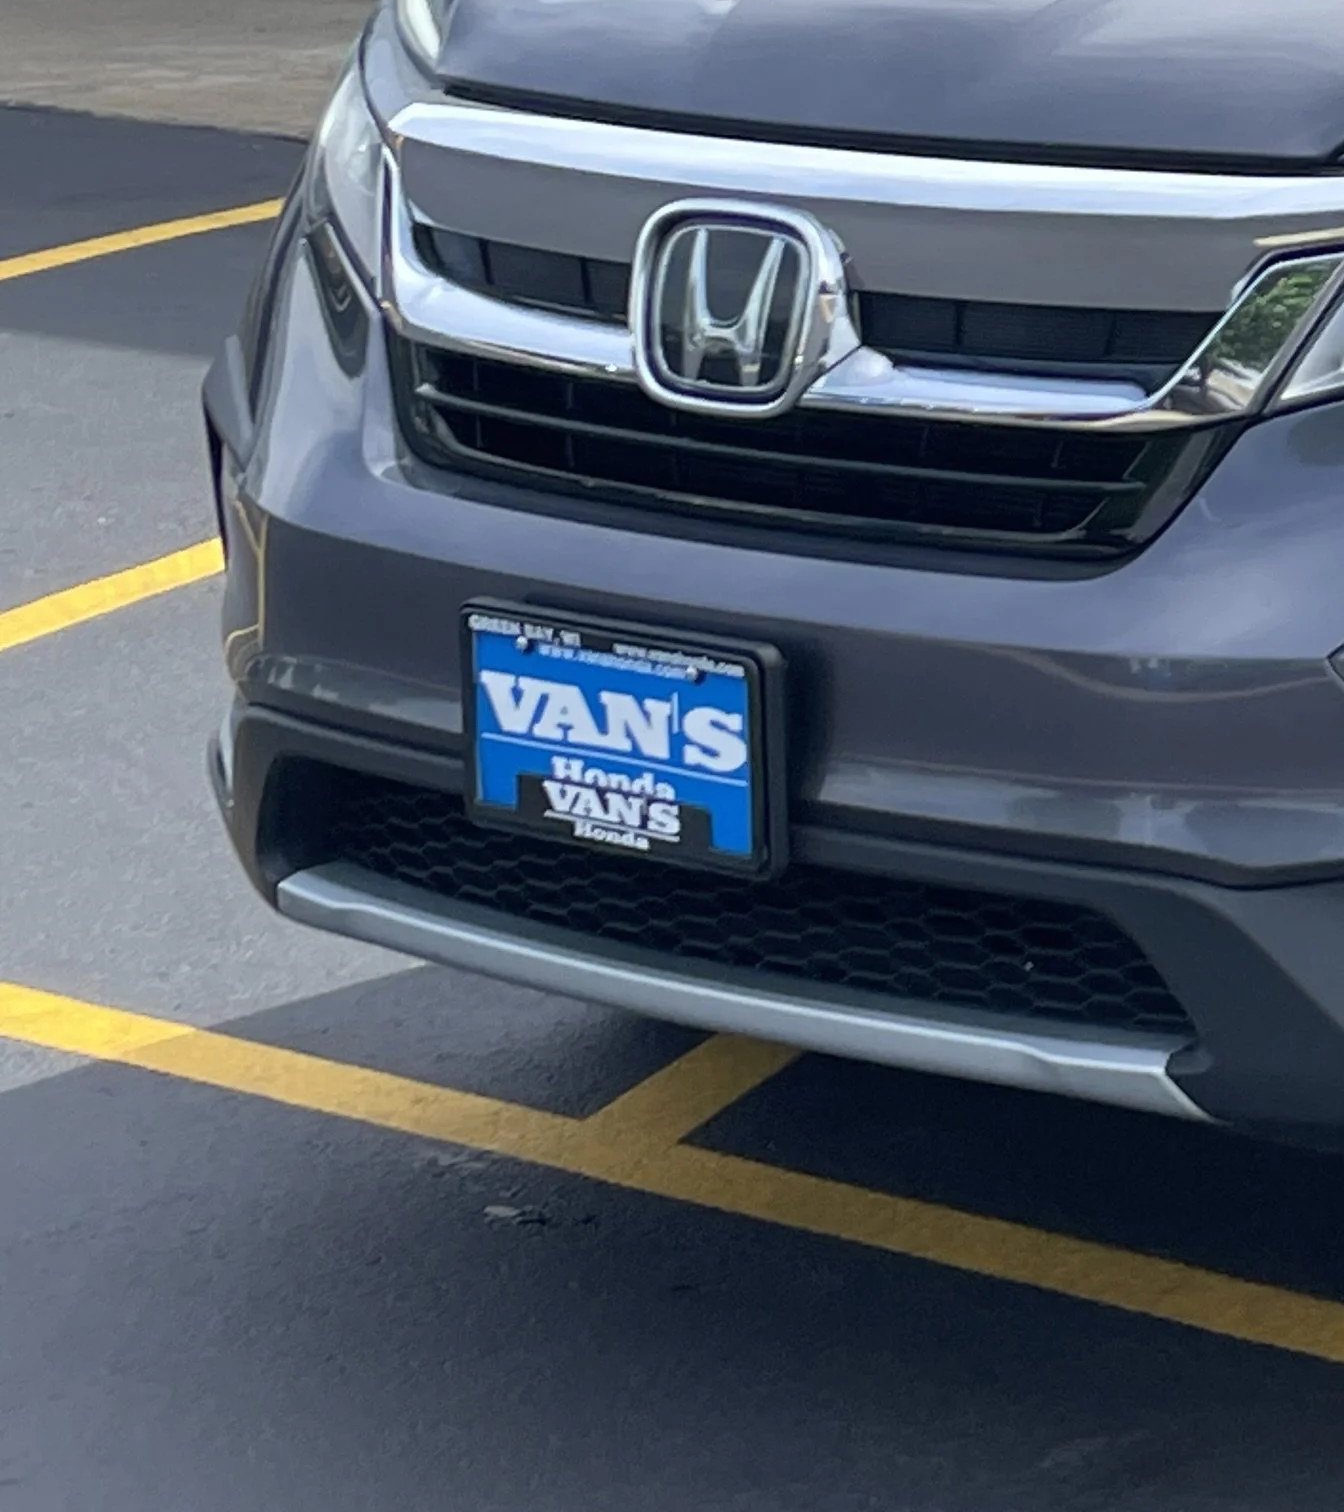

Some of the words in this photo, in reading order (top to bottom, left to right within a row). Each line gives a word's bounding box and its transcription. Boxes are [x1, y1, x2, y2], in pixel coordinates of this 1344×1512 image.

[480, 669, 748, 773] VAN'S
[551, 755, 676, 801] Honda
[542, 780, 681, 835] VAN'S
[573, 820, 650, 850] Honda
